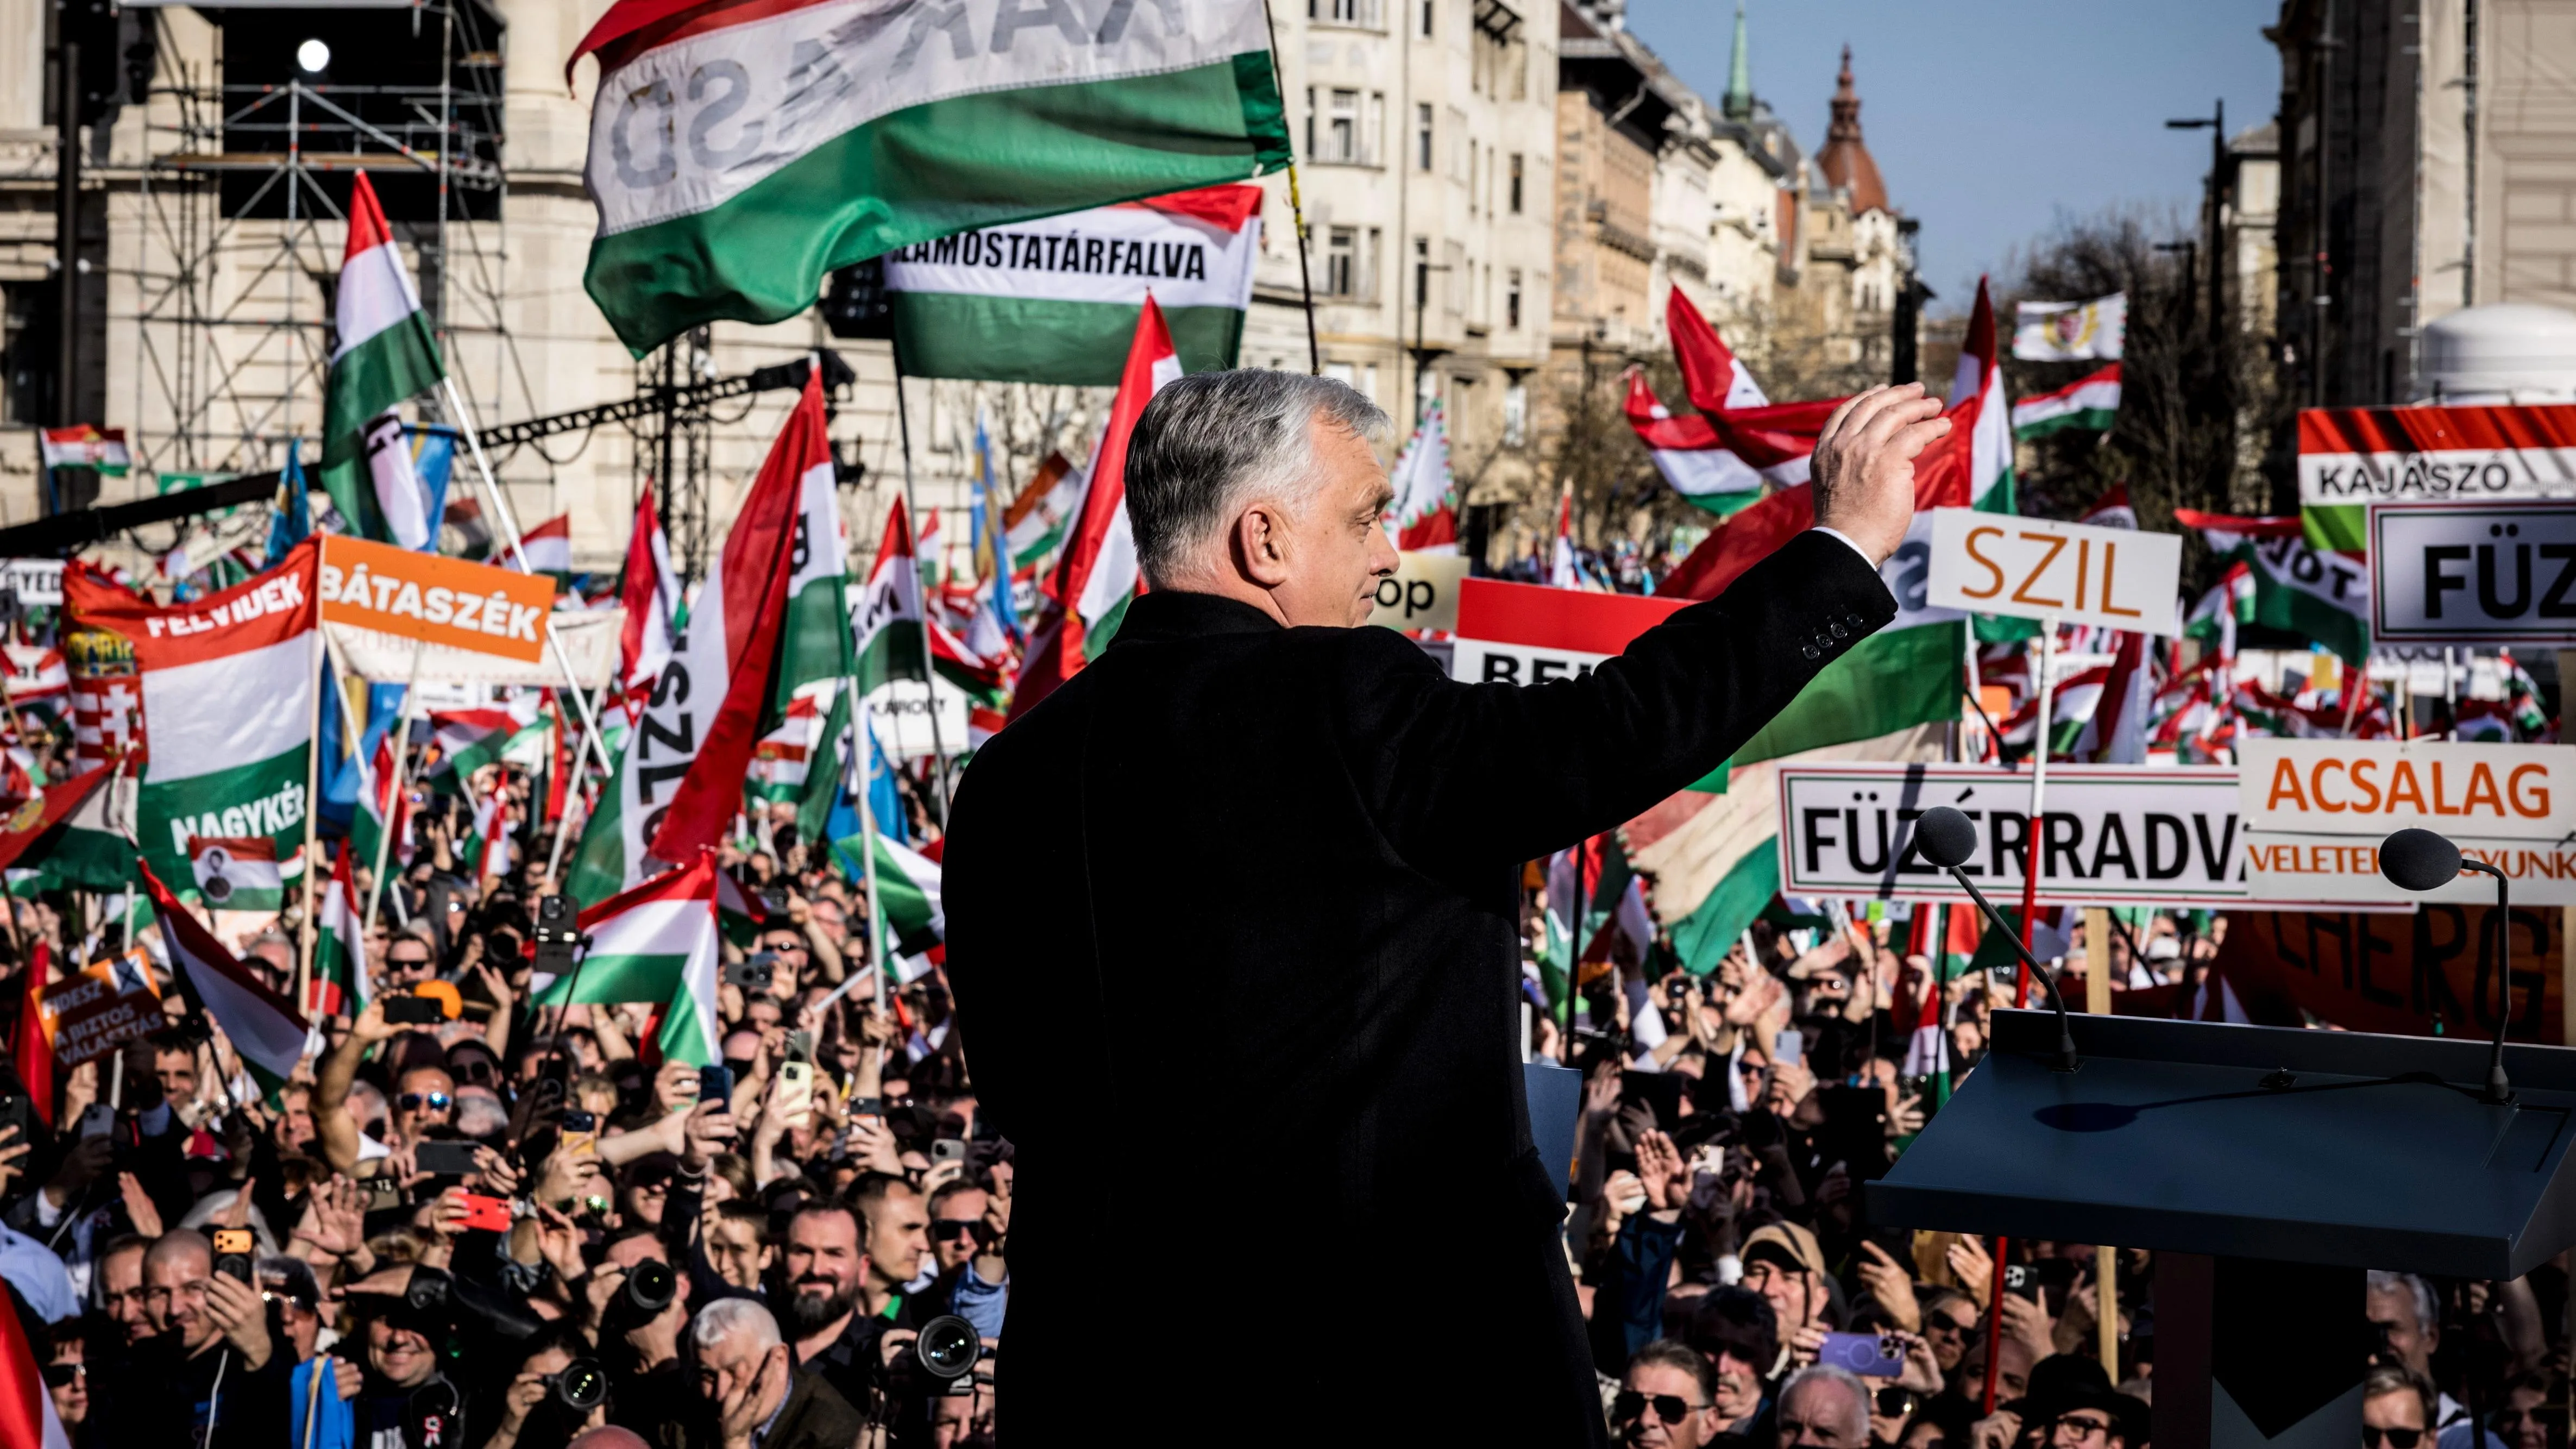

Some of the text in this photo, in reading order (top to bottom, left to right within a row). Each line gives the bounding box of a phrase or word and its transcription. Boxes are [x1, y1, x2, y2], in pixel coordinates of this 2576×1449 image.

[322, 562, 542, 643] BÁTASZÉK
[1961, 526, 2142, 618] SZIL
[2267, 758, 2550, 818] ACSALAG
[1804, 787, 2247, 881] FÜZRRADV
[2459, 849, 2576, 881] GYUNK
